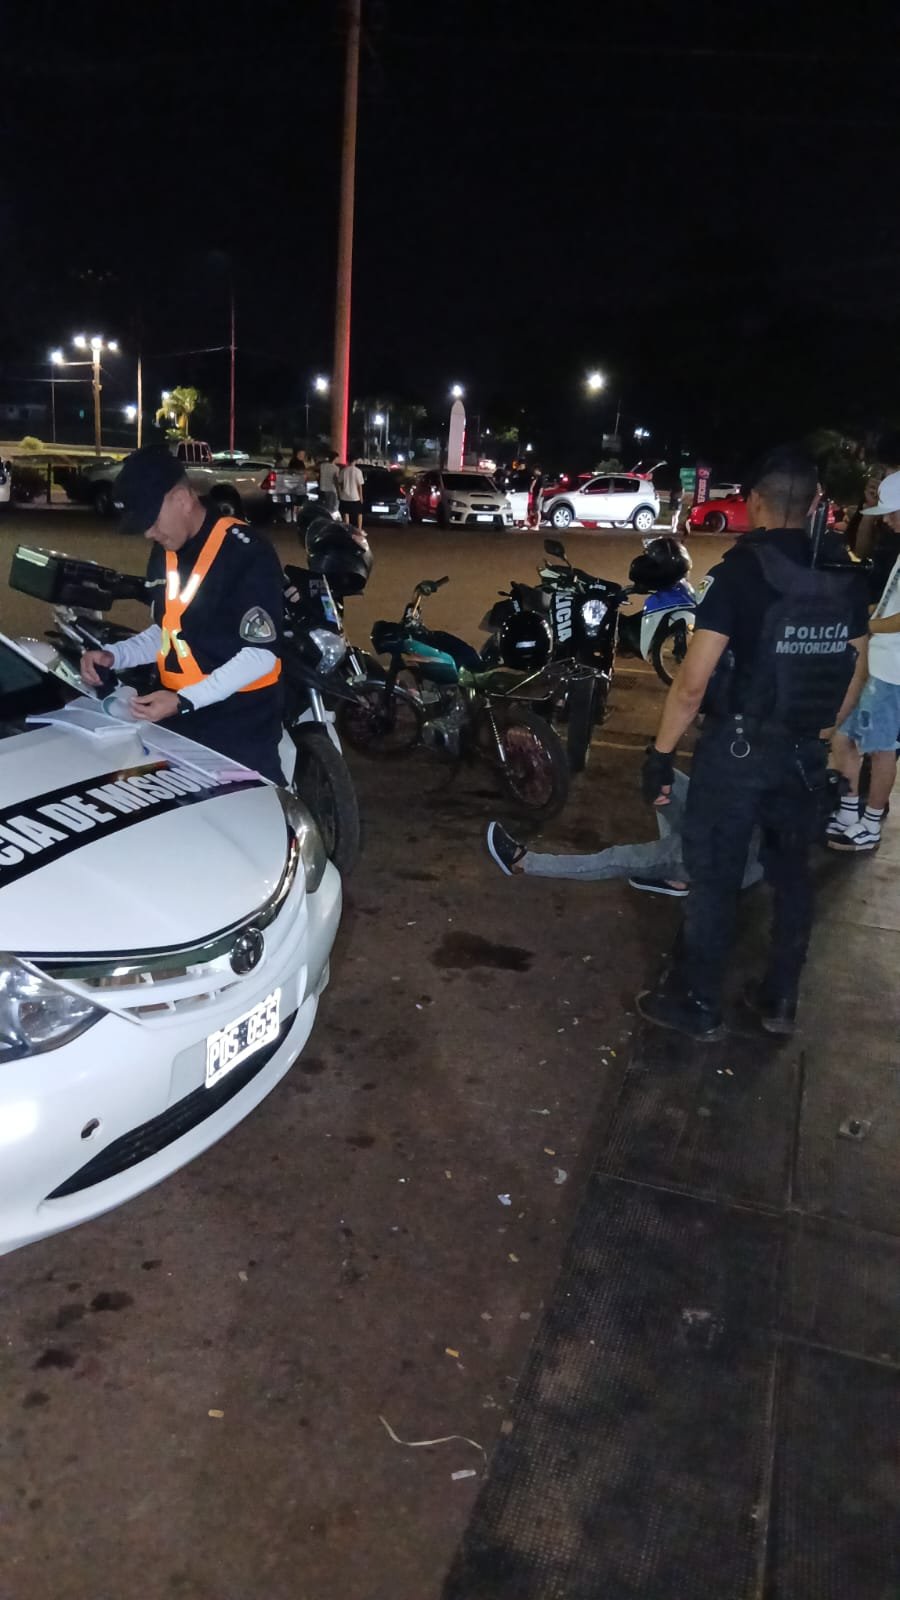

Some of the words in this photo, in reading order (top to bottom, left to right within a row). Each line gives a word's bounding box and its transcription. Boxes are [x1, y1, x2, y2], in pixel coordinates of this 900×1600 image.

[555, 591, 573, 642] LICIA
[784, 622, 849, 639] POLICÍA
[775, 641, 847, 654] MOTORIZAD
[36, 795, 118, 833] DE
